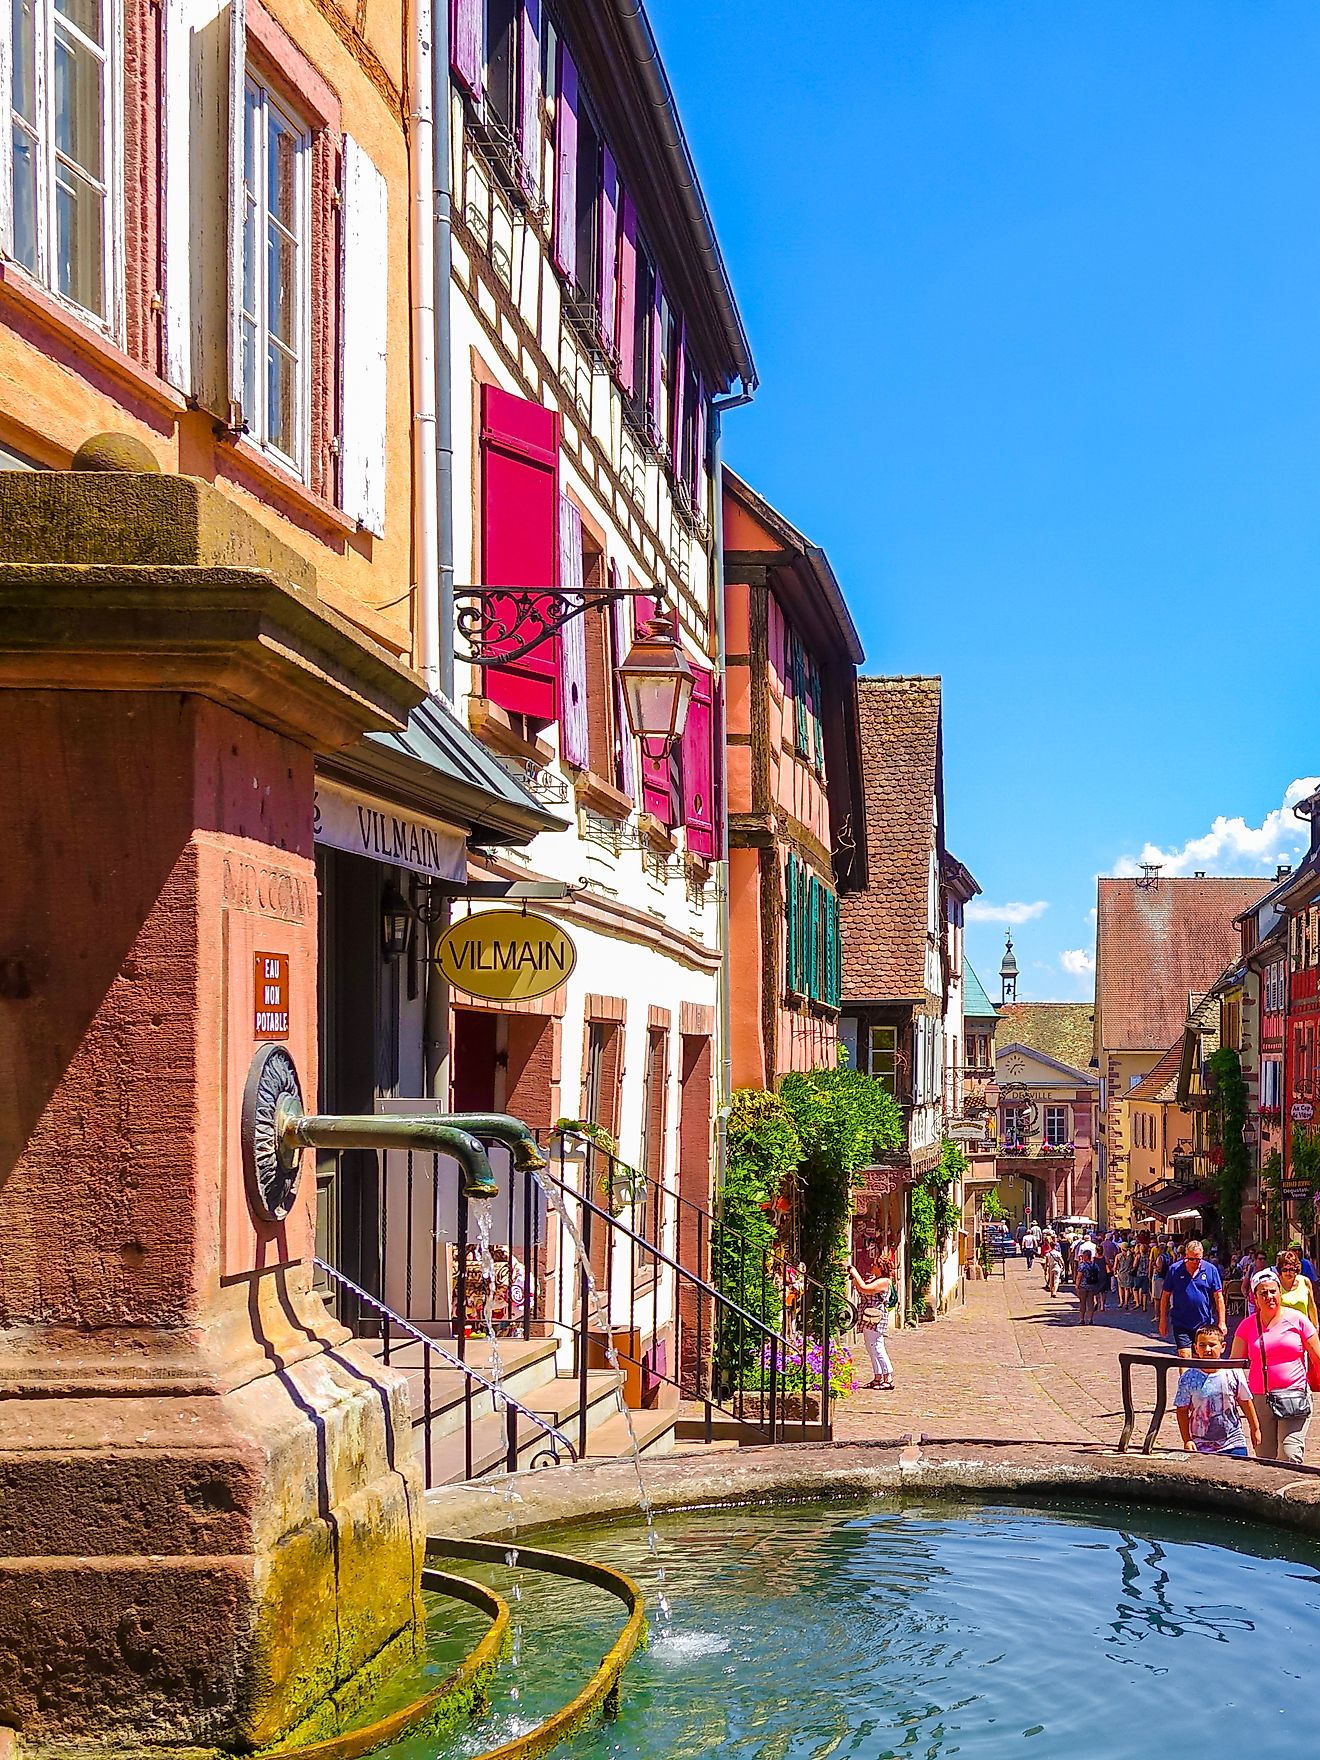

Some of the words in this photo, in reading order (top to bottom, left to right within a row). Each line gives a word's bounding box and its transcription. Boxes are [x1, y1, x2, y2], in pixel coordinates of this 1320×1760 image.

[358, 806, 440, 871] VILMAIN
[448, 940, 565, 971] VILMAIN
[264, 959, 280, 979] EAU
[264, 986, 280, 1005] NON
[256, 1012, 288, 1032] POTABLE
